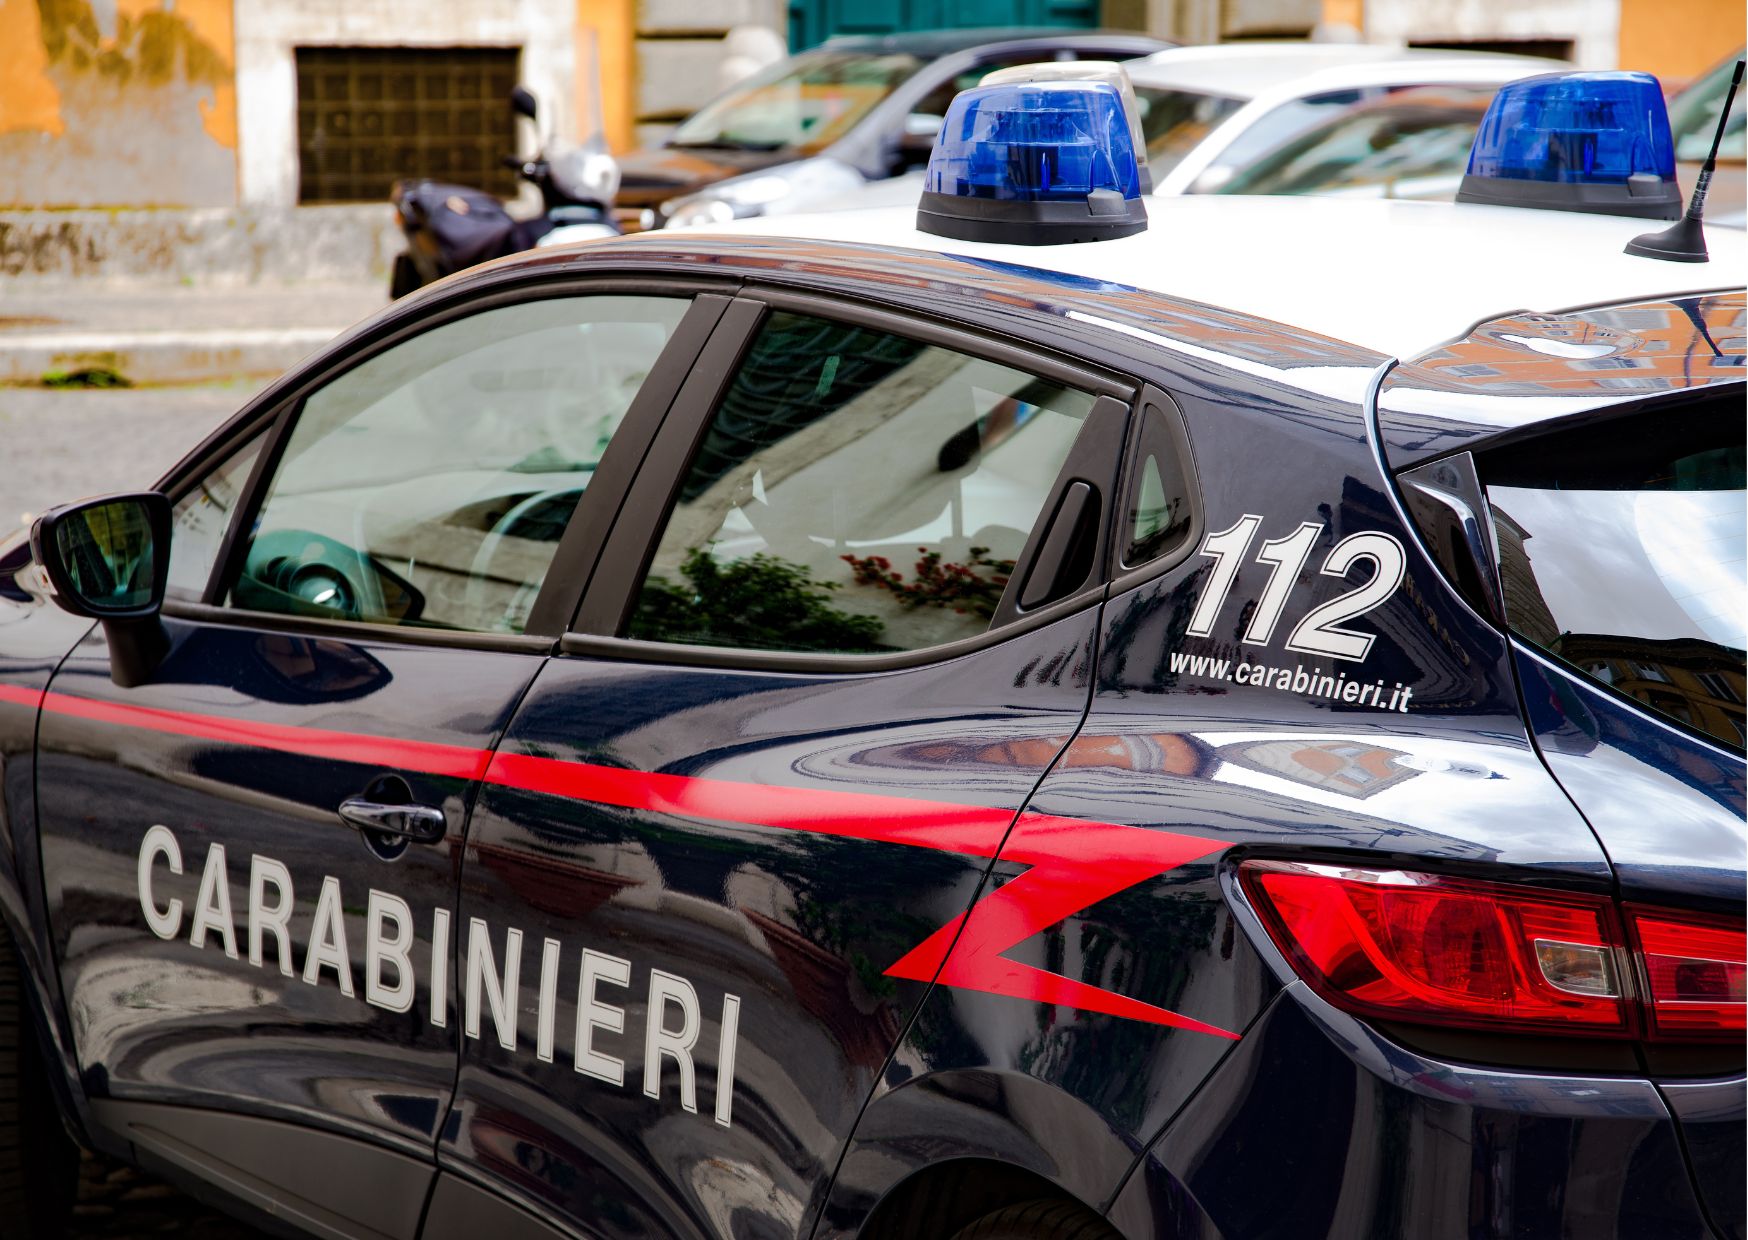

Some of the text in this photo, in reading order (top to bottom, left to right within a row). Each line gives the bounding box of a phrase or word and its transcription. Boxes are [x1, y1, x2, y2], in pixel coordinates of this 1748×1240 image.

[1185, 514, 1408, 664] 112
[1170, 652, 1413, 713] www.carabinieri.it
[138, 825, 741, 1128] CARABINIERI
